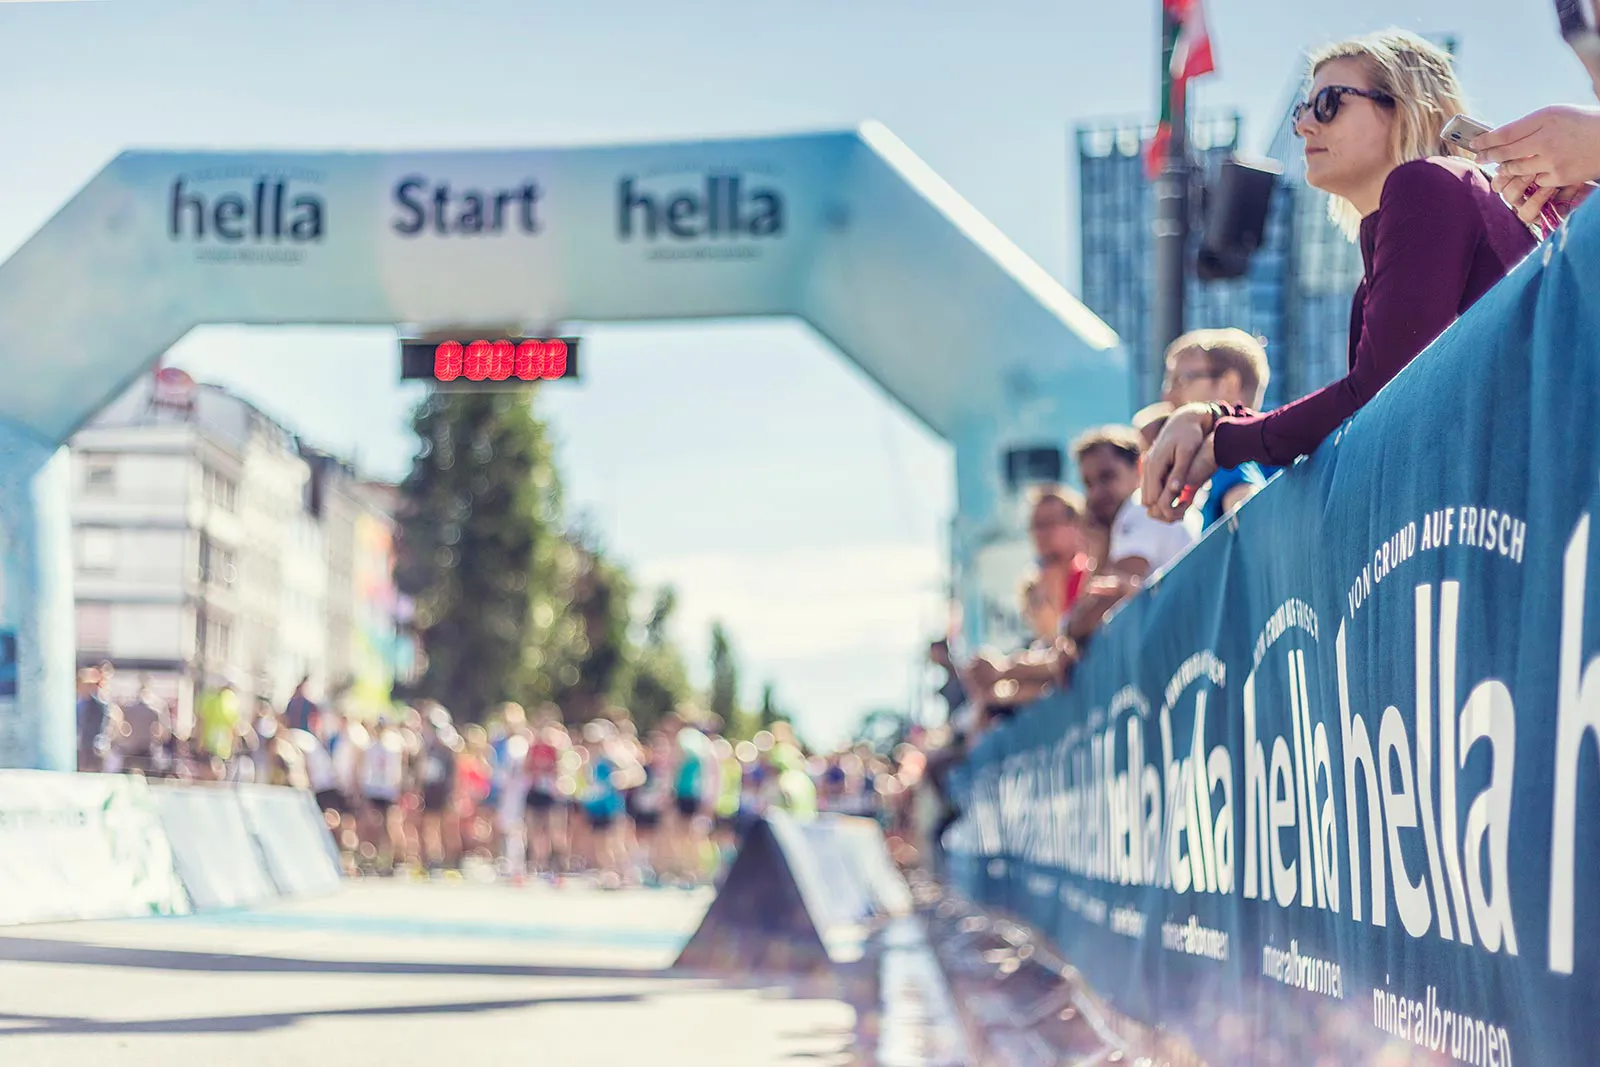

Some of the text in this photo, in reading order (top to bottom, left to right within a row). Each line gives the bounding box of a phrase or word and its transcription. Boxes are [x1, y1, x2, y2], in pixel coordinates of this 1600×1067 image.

[168, 175, 325, 242] hella
[393, 176, 545, 236] Start
[617, 174, 787, 242] hella
[1348, 506, 1526, 619] VON GRUND AUF FRISCH
[1243, 648, 1340, 913] hella
[1336, 580, 1519, 957] hella
[1372, 974, 1513, 1067] mineralbrunnen
